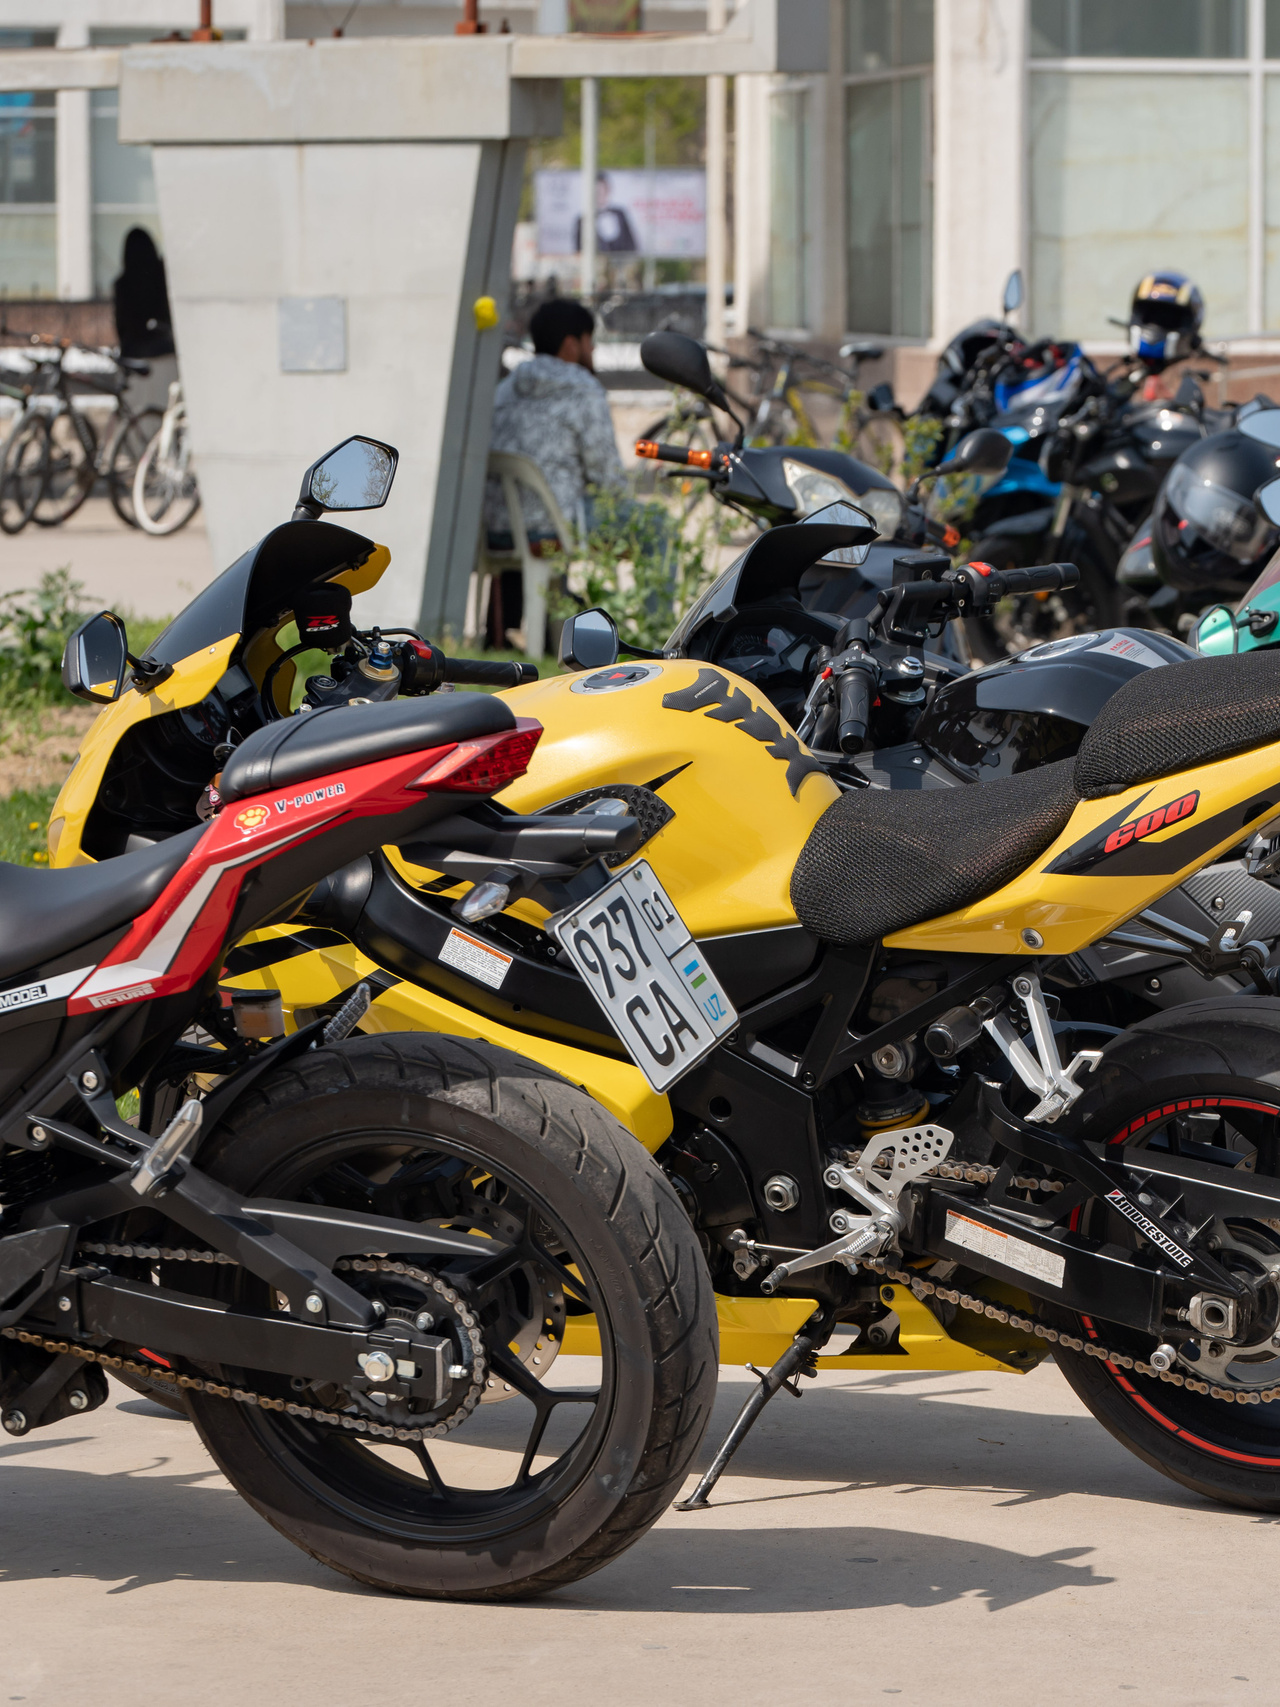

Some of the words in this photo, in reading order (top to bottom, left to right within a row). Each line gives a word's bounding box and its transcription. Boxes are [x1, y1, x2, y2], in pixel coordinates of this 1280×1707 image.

[274, 783, 346, 814] V-POWER
[1104, 793, 1197, 853] 600
[641, 891, 675, 931] 01
[573, 896, 651, 999] 937
[626, 980, 699, 1067] CA
[703, 993, 727, 1021] UZ
[1104, 1188, 1194, 1268] BRIDGESTONE
